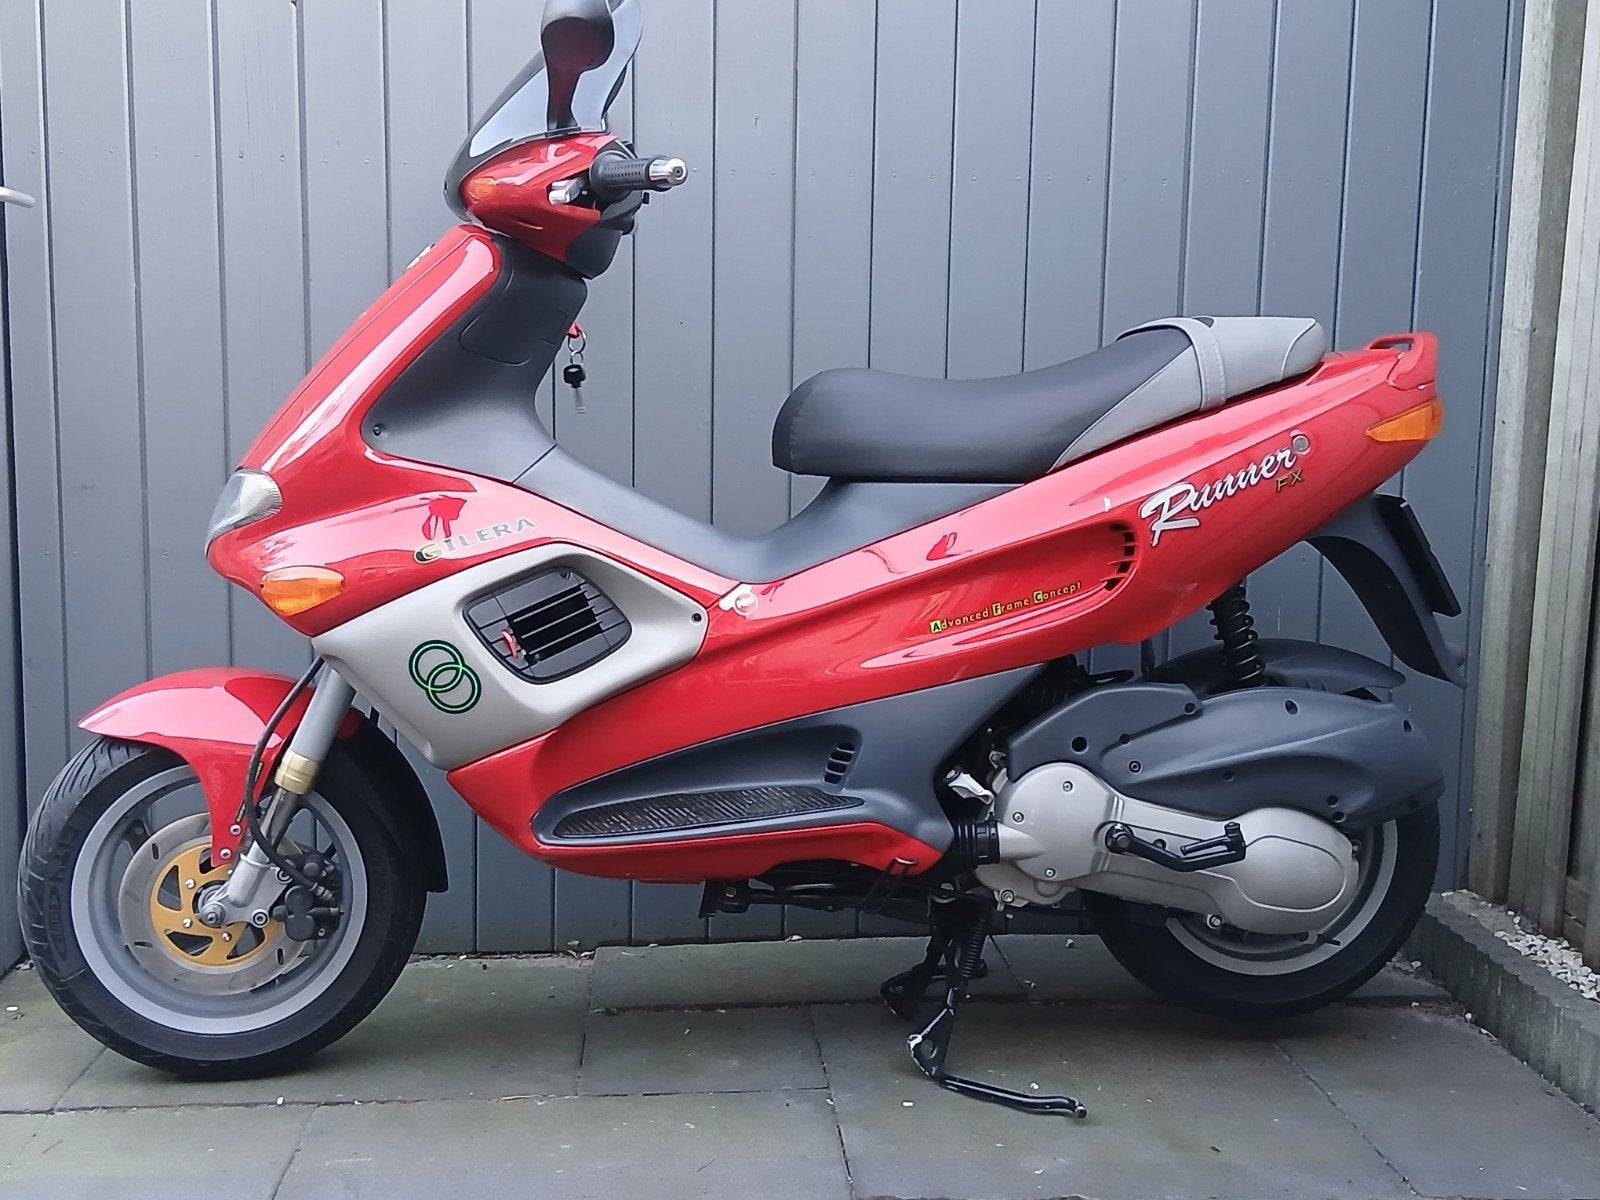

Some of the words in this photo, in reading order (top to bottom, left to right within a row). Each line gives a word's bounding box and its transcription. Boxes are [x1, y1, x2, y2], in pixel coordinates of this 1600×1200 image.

[1139, 446, 1298, 547] Runner
[1276, 469, 1303, 492] FX
[414, 518, 536, 562] GILERA
[930, 607, 989, 634] Advanced
[992, 597, 1030, 616] Frame
[1033, 581, 1082, 604] Concept
